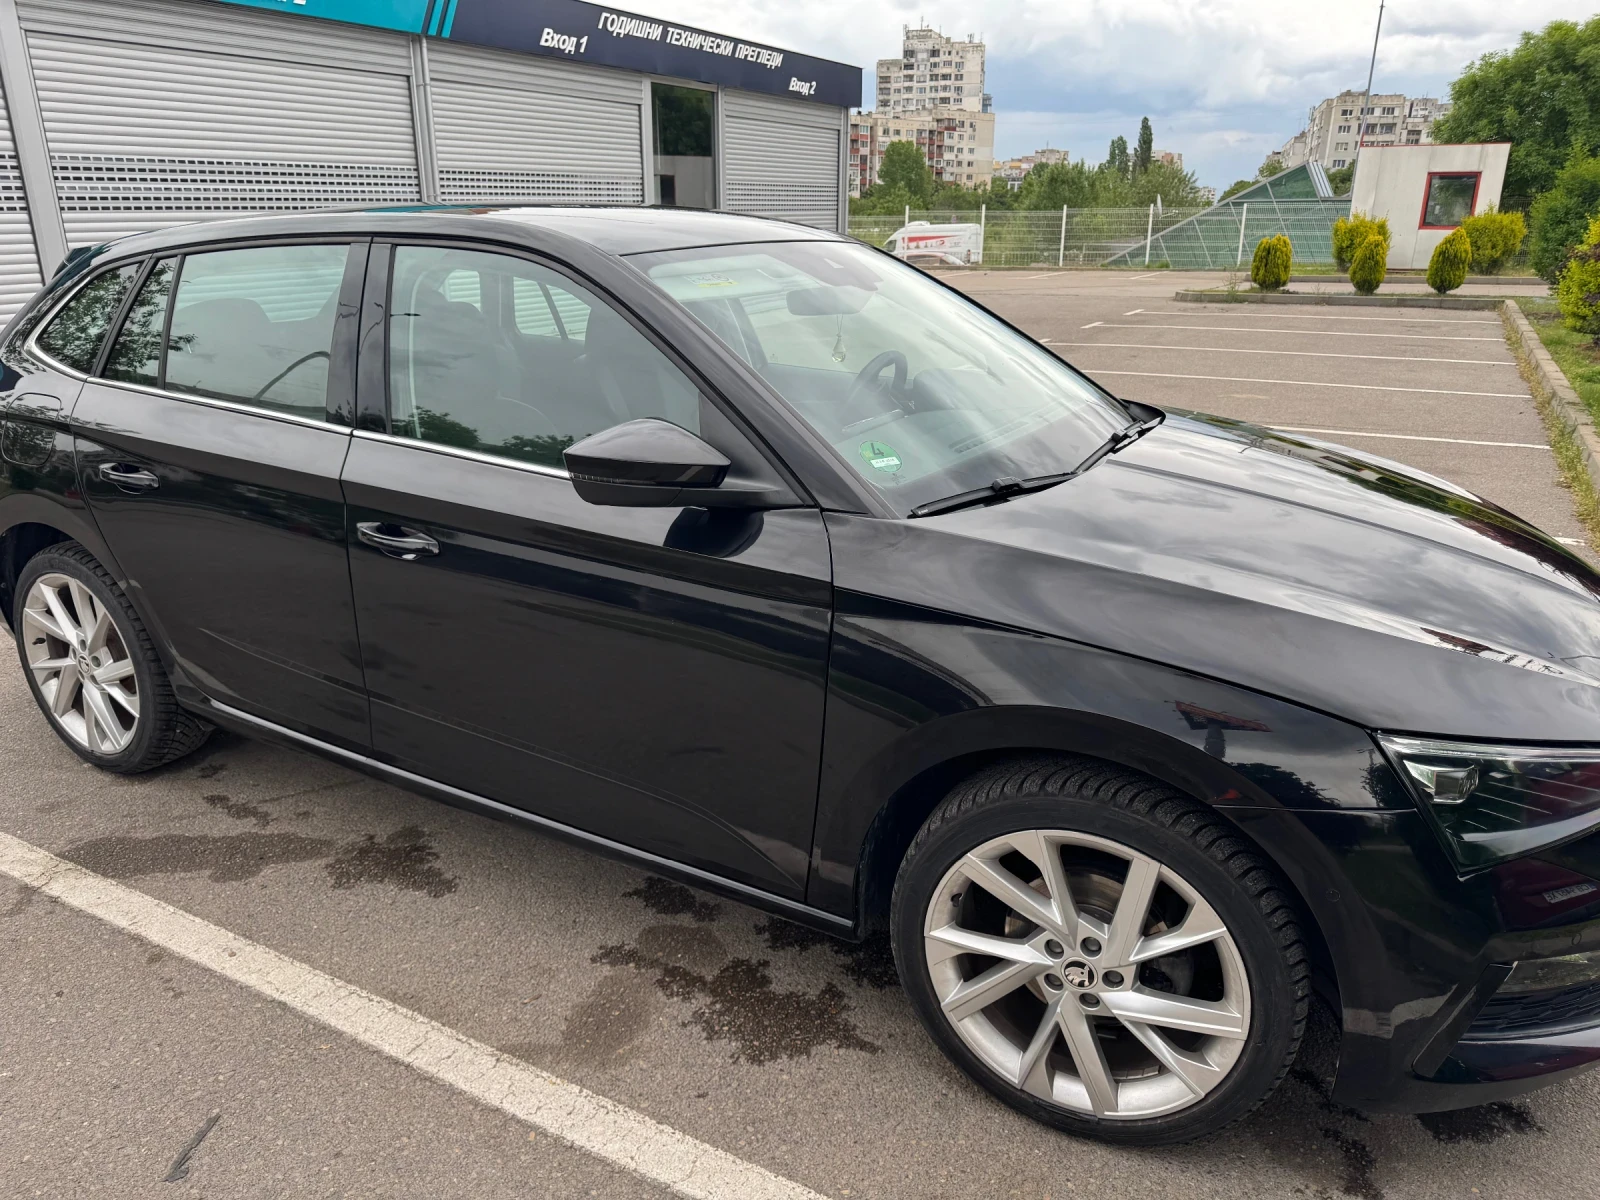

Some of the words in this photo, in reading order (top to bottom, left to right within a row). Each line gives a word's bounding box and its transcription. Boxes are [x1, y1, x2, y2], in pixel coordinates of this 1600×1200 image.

[539, 27, 577, 55] Вход
[579, 35, 589, 53] 1
[598, 12, 663, 41] ГОДИШНИ
[665, 27, 734, 57] ТЕХНИЧЕСКИ
[734, 43, 784, 70] ПРЕГЛЕДИ
[788, 77, 810, 96] Вход
[809, 81, 817, 95] 2
